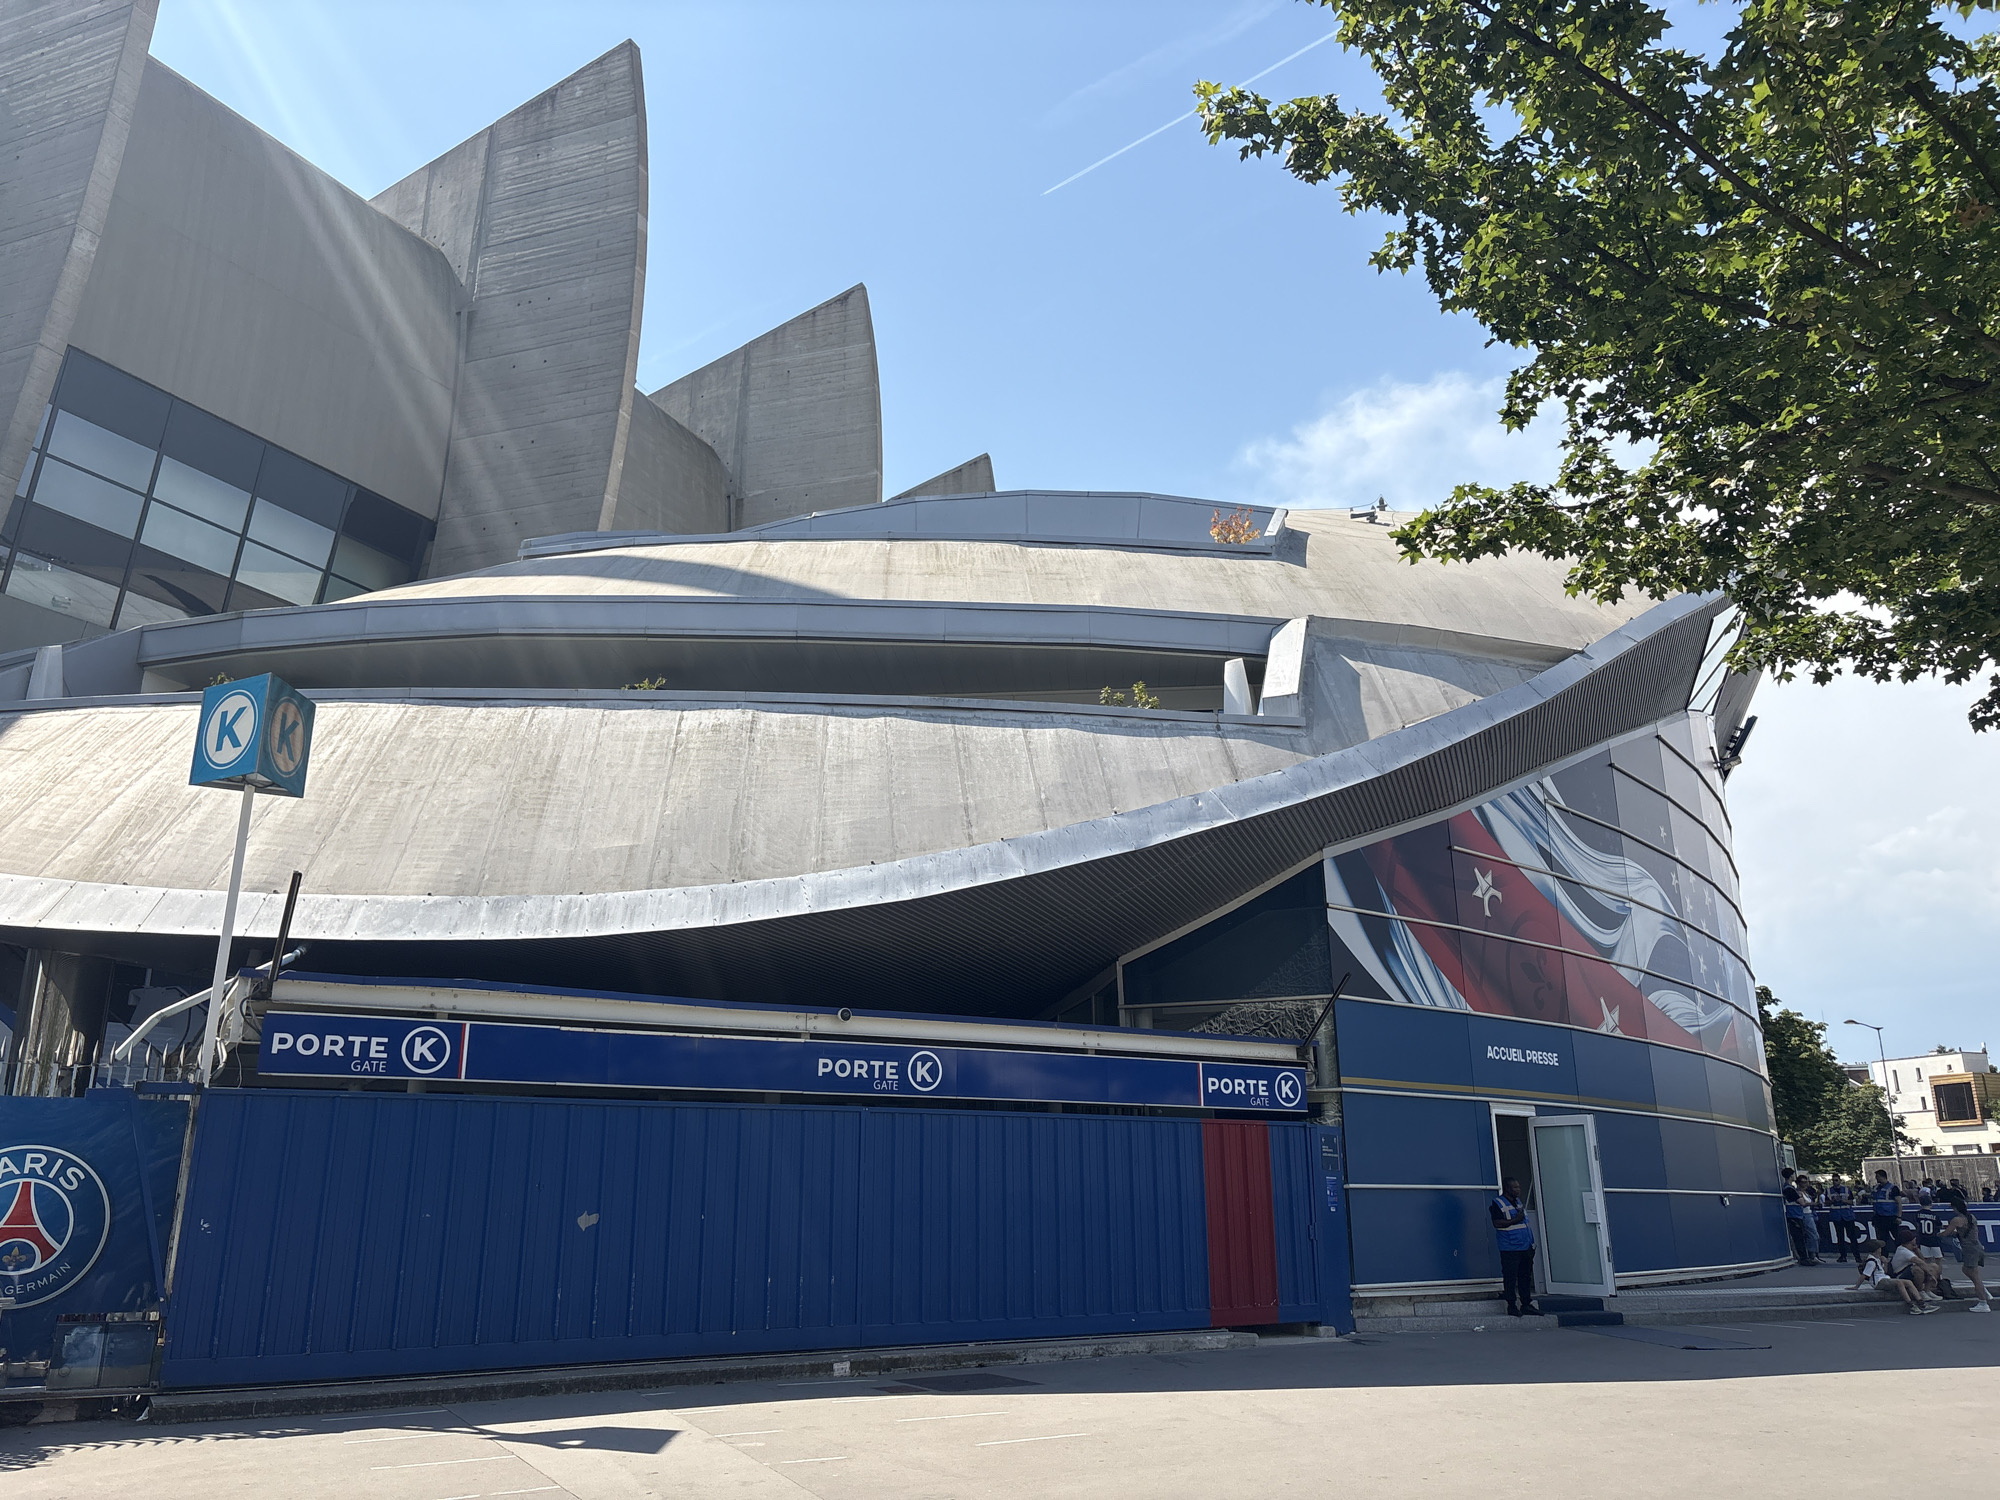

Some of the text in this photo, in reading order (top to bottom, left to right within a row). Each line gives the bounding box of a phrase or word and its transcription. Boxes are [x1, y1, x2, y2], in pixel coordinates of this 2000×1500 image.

[215, 706, 248, 752] K
[276, 713, 299, 762] K
[271, 1032, 439, 1062] PORTE K
[1487, 1045, 1559, 1066] ACCUEIL PRESSE
[350, 1060, 387, 1073] GATE
[818, 1058, 933, 1083] PORTE K
[873, 1080, 899, 1091] GATE
[1207, 1077, 1295, 1099] PORTE K
[1250, 1097, 1270, 1107] GATE
[0, 1153, 86, 1191] ARIS
[1920, 1220, 1933, 1235] 10
[4, 1262, 71, 1295] GERMAIN
